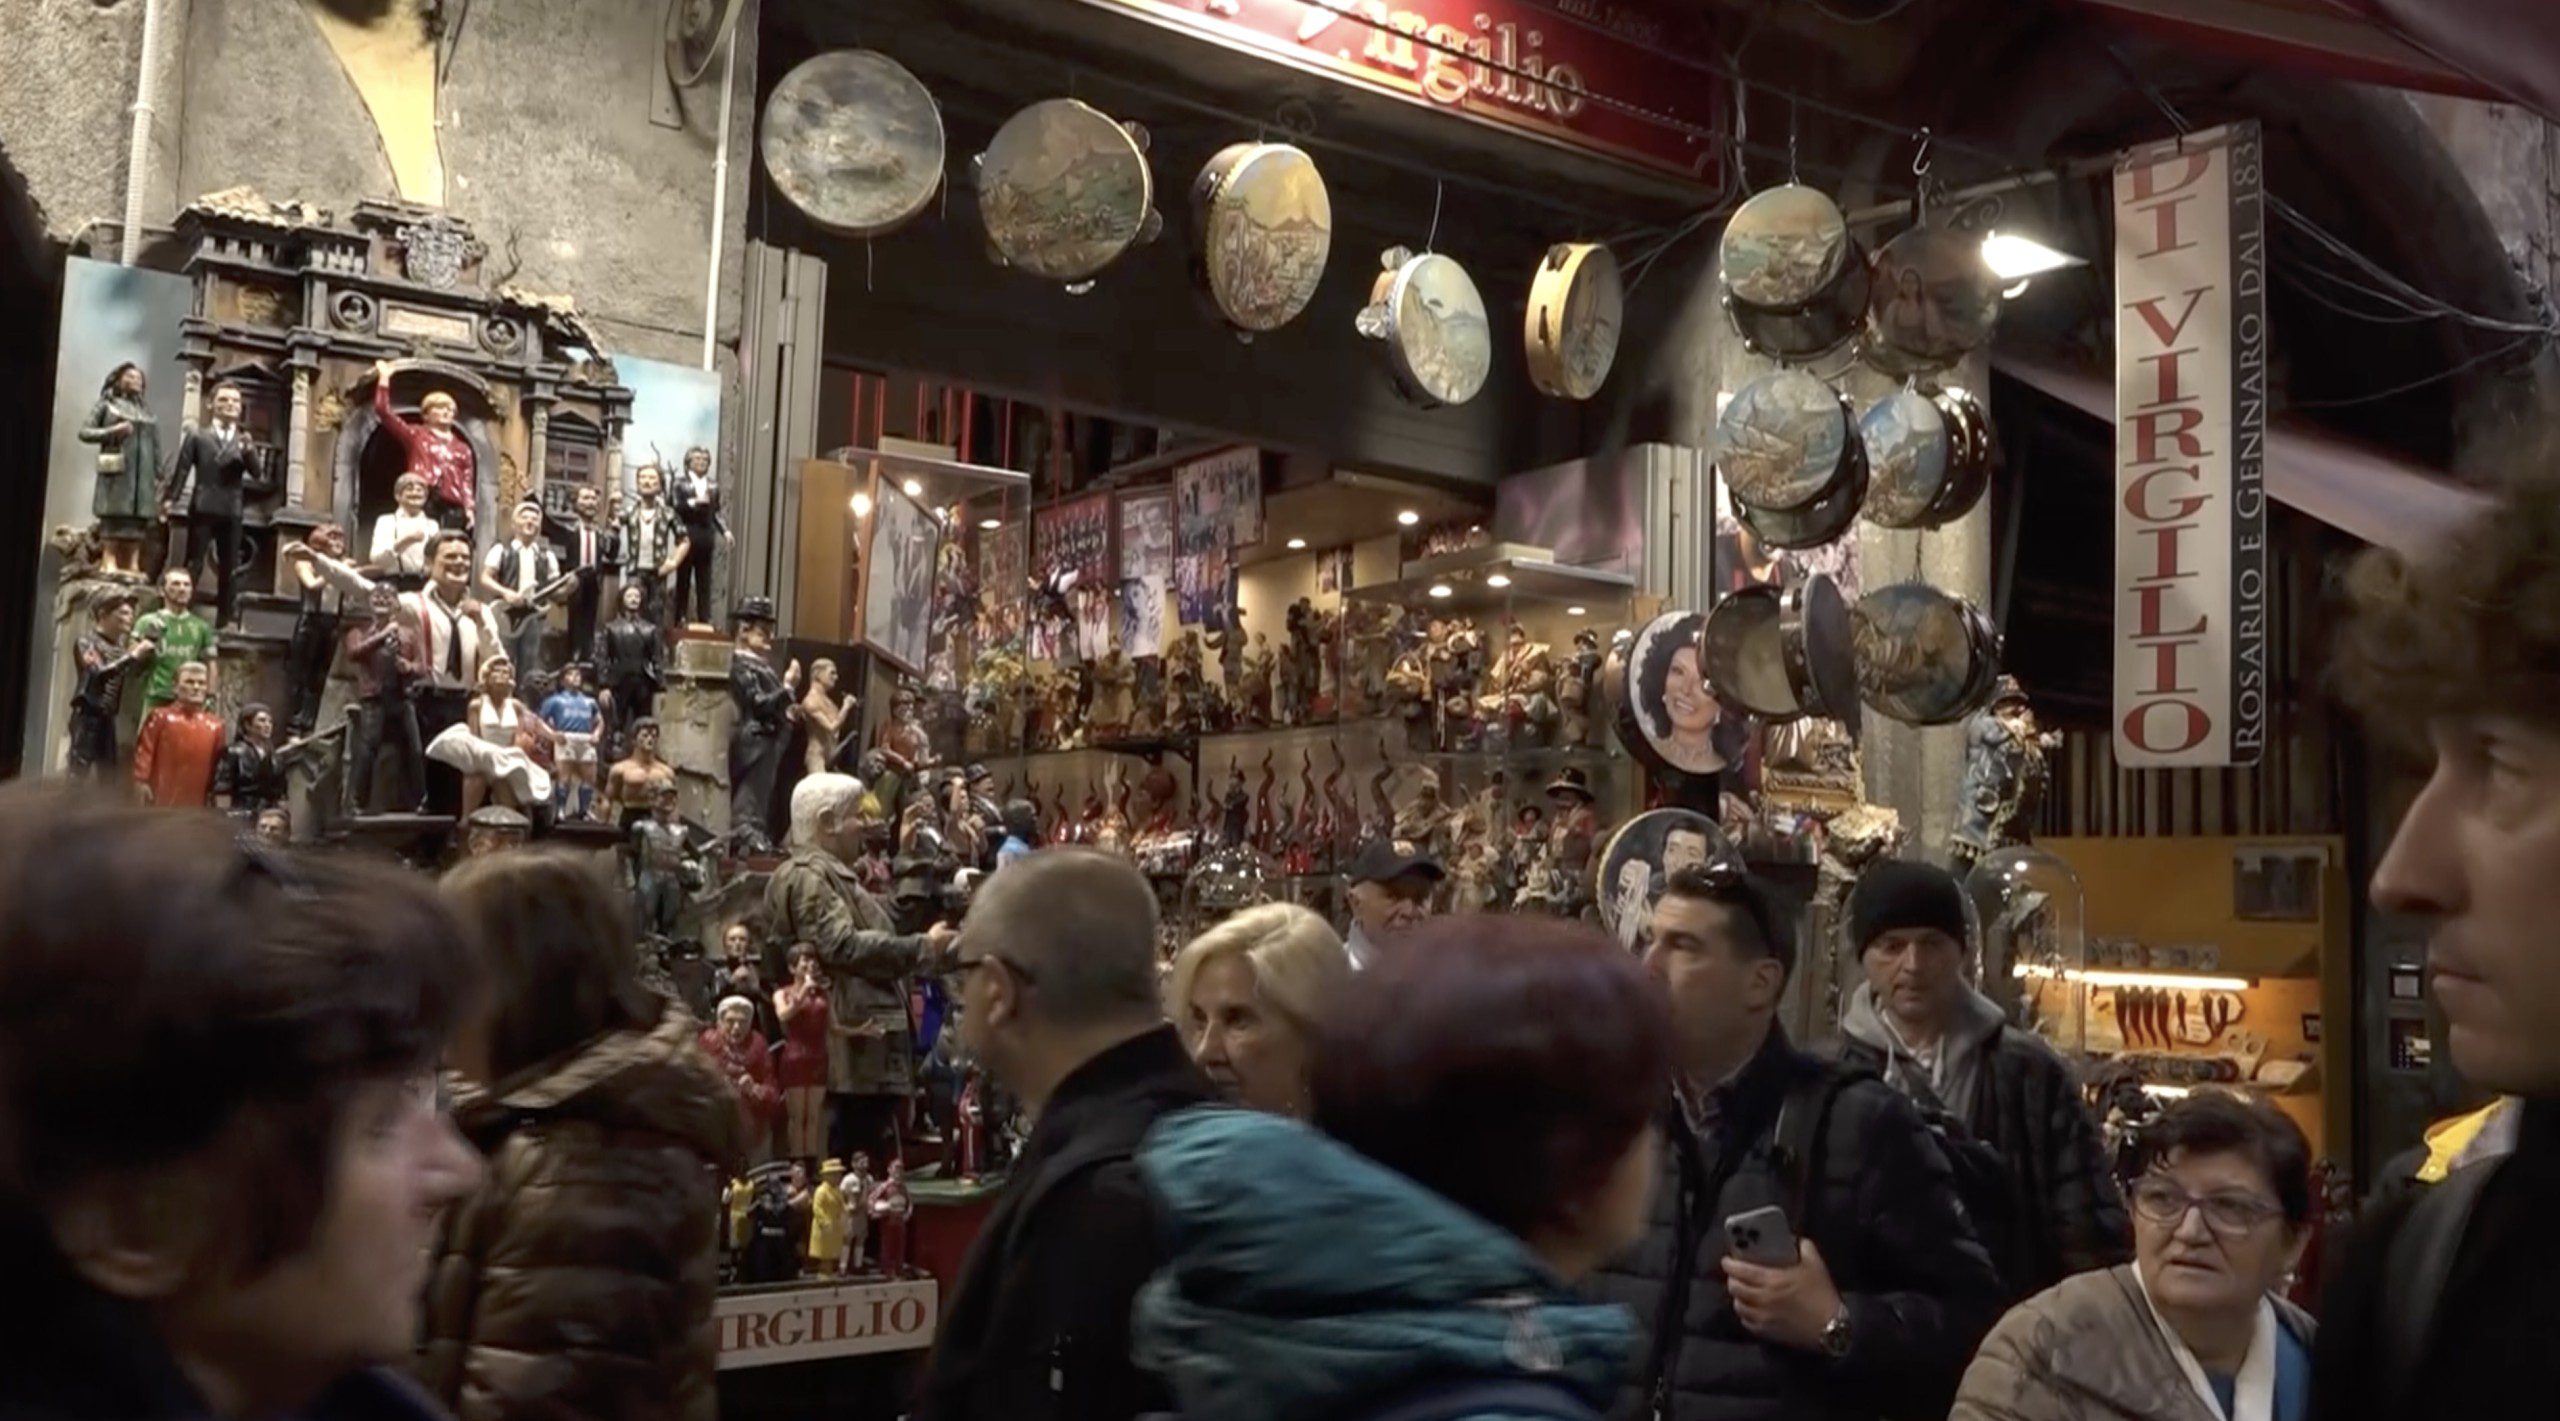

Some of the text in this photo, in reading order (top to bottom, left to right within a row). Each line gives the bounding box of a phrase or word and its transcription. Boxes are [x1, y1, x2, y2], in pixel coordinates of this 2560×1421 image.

[2122, 152, 2214, 753] DI VIRGILIO
[2232, 126, 2262, 751] ROSARIO E GENNARO DAL 183
